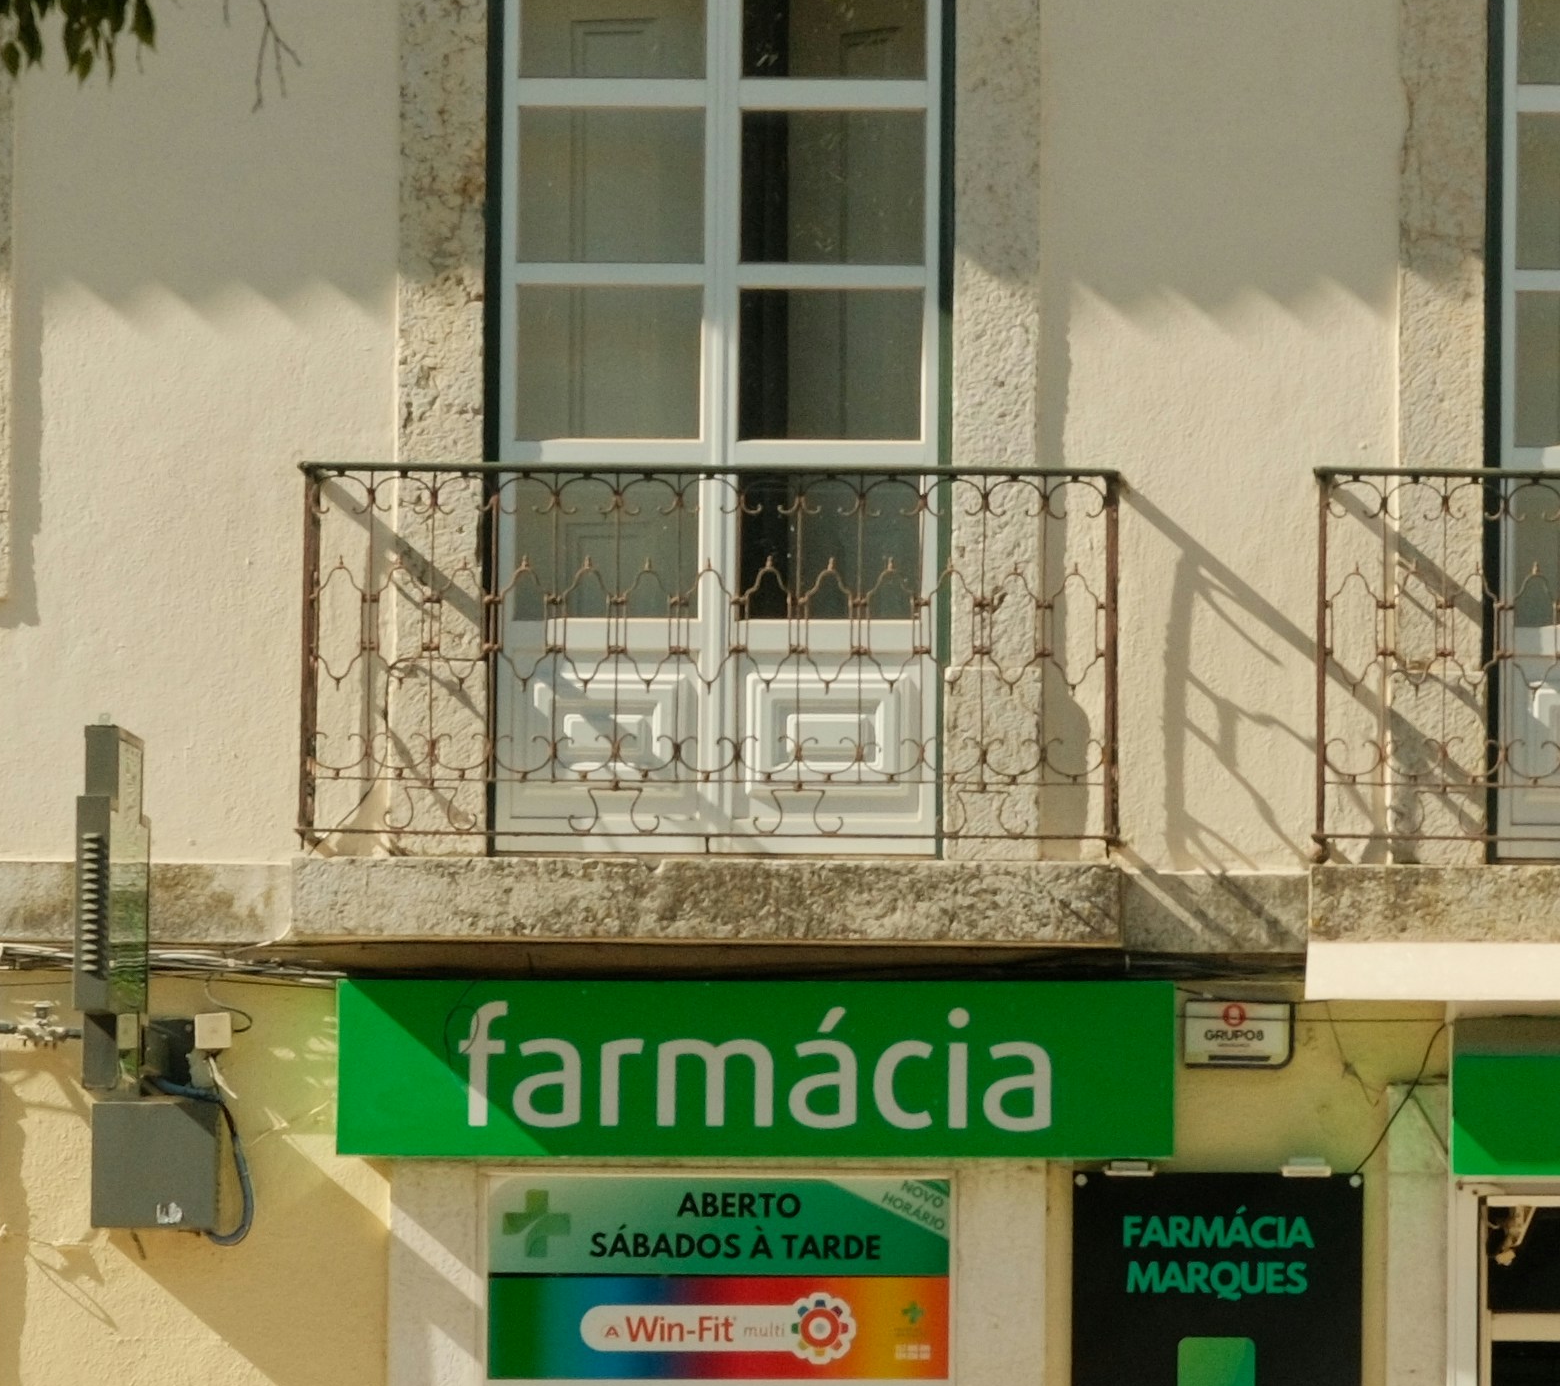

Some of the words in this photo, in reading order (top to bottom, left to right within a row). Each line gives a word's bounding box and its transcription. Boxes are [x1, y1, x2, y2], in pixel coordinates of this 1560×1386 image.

[457, 1000, 1053, 1131] farmácia
[676, 1192, 801, 1219] ABERTO
[881, 1191, 945, 1230] HORÁRIO
[901, 1180, 945, 1208] NOVO
[590, 1224, 741, 1259] SÁBADOS
[749, 1226, 774, 1259] À
[782, 1234, 881, 1260] TARDE
[1123, 1205, 1315, 1248] FARMÁCIA
[1126, 1261, 1308, 1301] MARQUES
[625, 1315, 734, 1344] Win-Fit
[743, 1323, 785, 1339] multi
